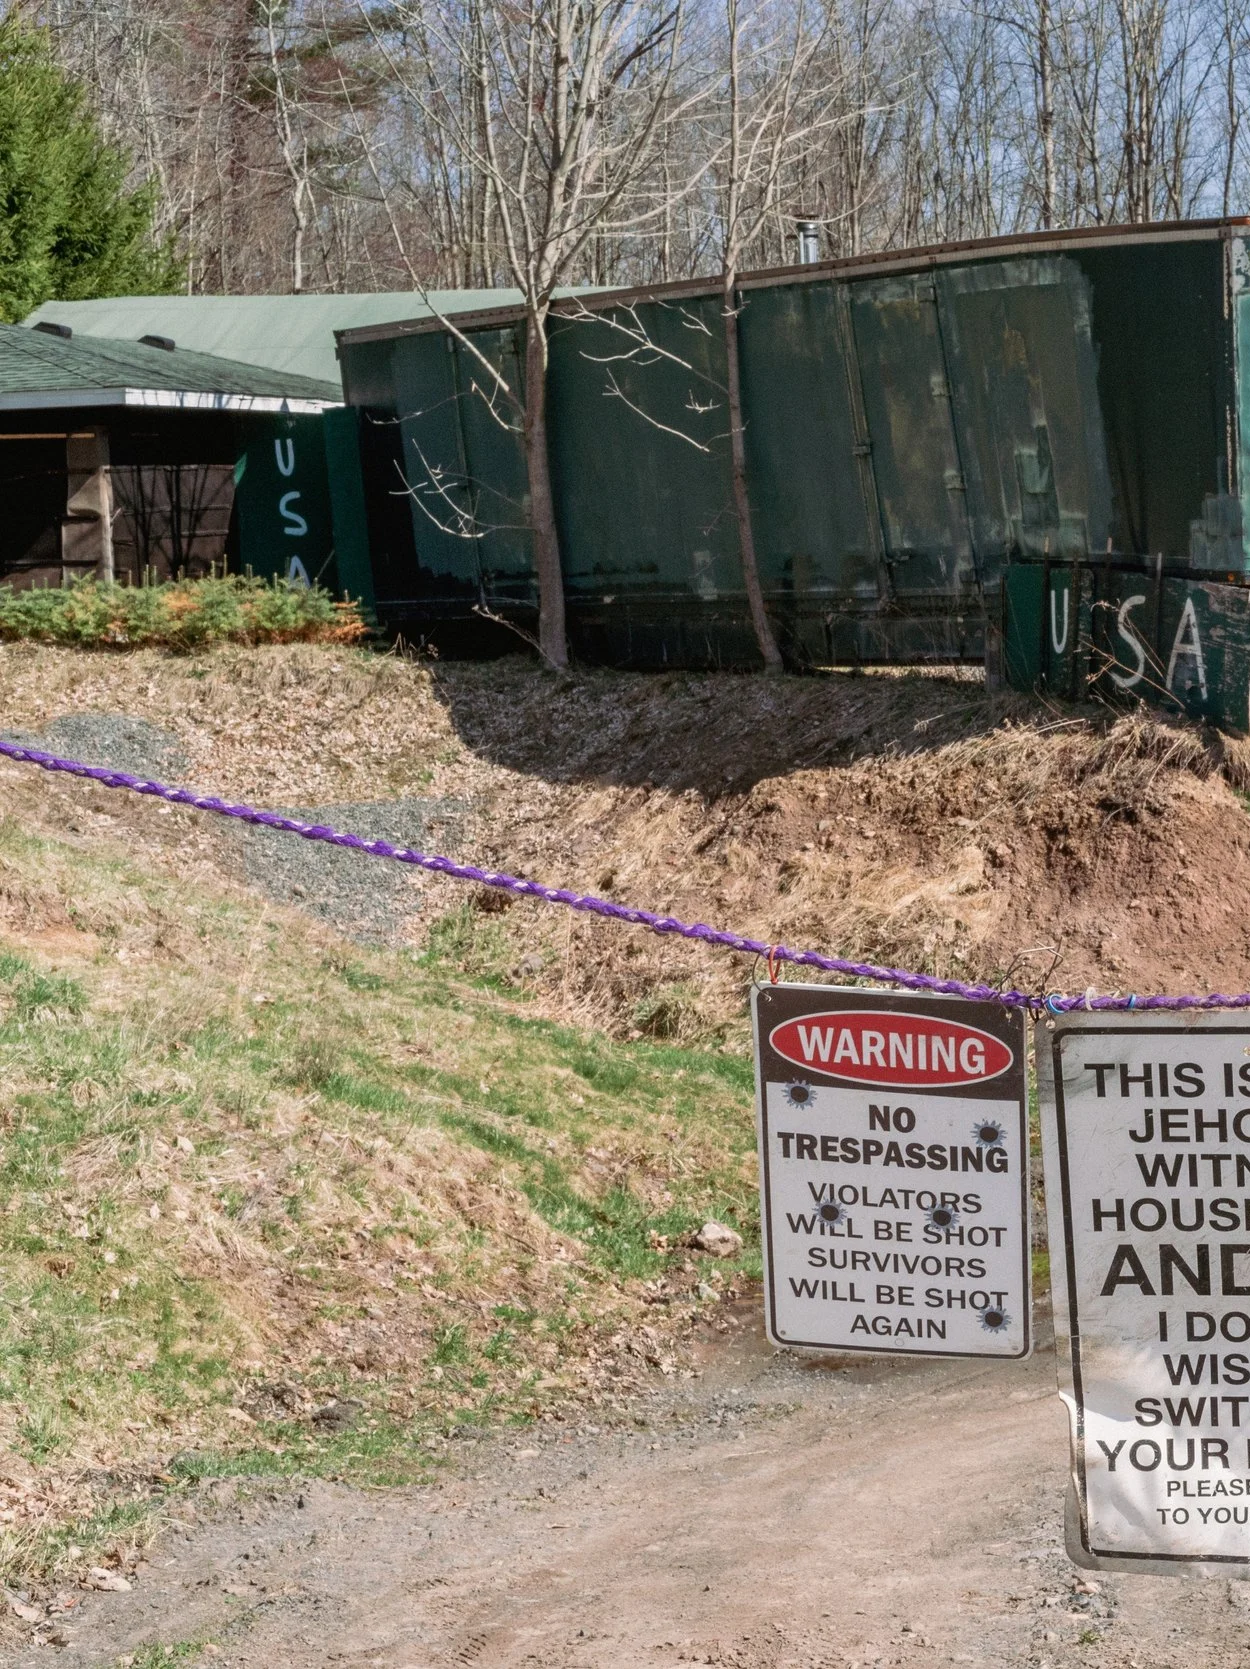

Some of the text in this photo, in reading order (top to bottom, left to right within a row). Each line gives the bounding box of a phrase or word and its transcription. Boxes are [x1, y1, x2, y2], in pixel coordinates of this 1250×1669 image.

[1051, 588, 1208, 700] USA
[797, 1025, 986, 1075] WARNING
[1084, 1062, 1206, 1098] THIS
[869, 1104, 916, 1133] NO
[777, 1132, 1009, 1174] TRESPASSING
[807, 1181, 982, 1214] VIOLATORS
[786, 1212, 1008, 1248] WILL BE SHOT
[807, 1247, 986, 1279] SURVIVORS
[789, 1277, 1009, 1311] WILL BE SHOT
[850, 1314, 947, 1340] AGAIN
[1158, 1311, 1168, 1343] I
[1096, 1438, 1229, 1472] YOUR
[1157, 1507, 1190, 1526] TO
